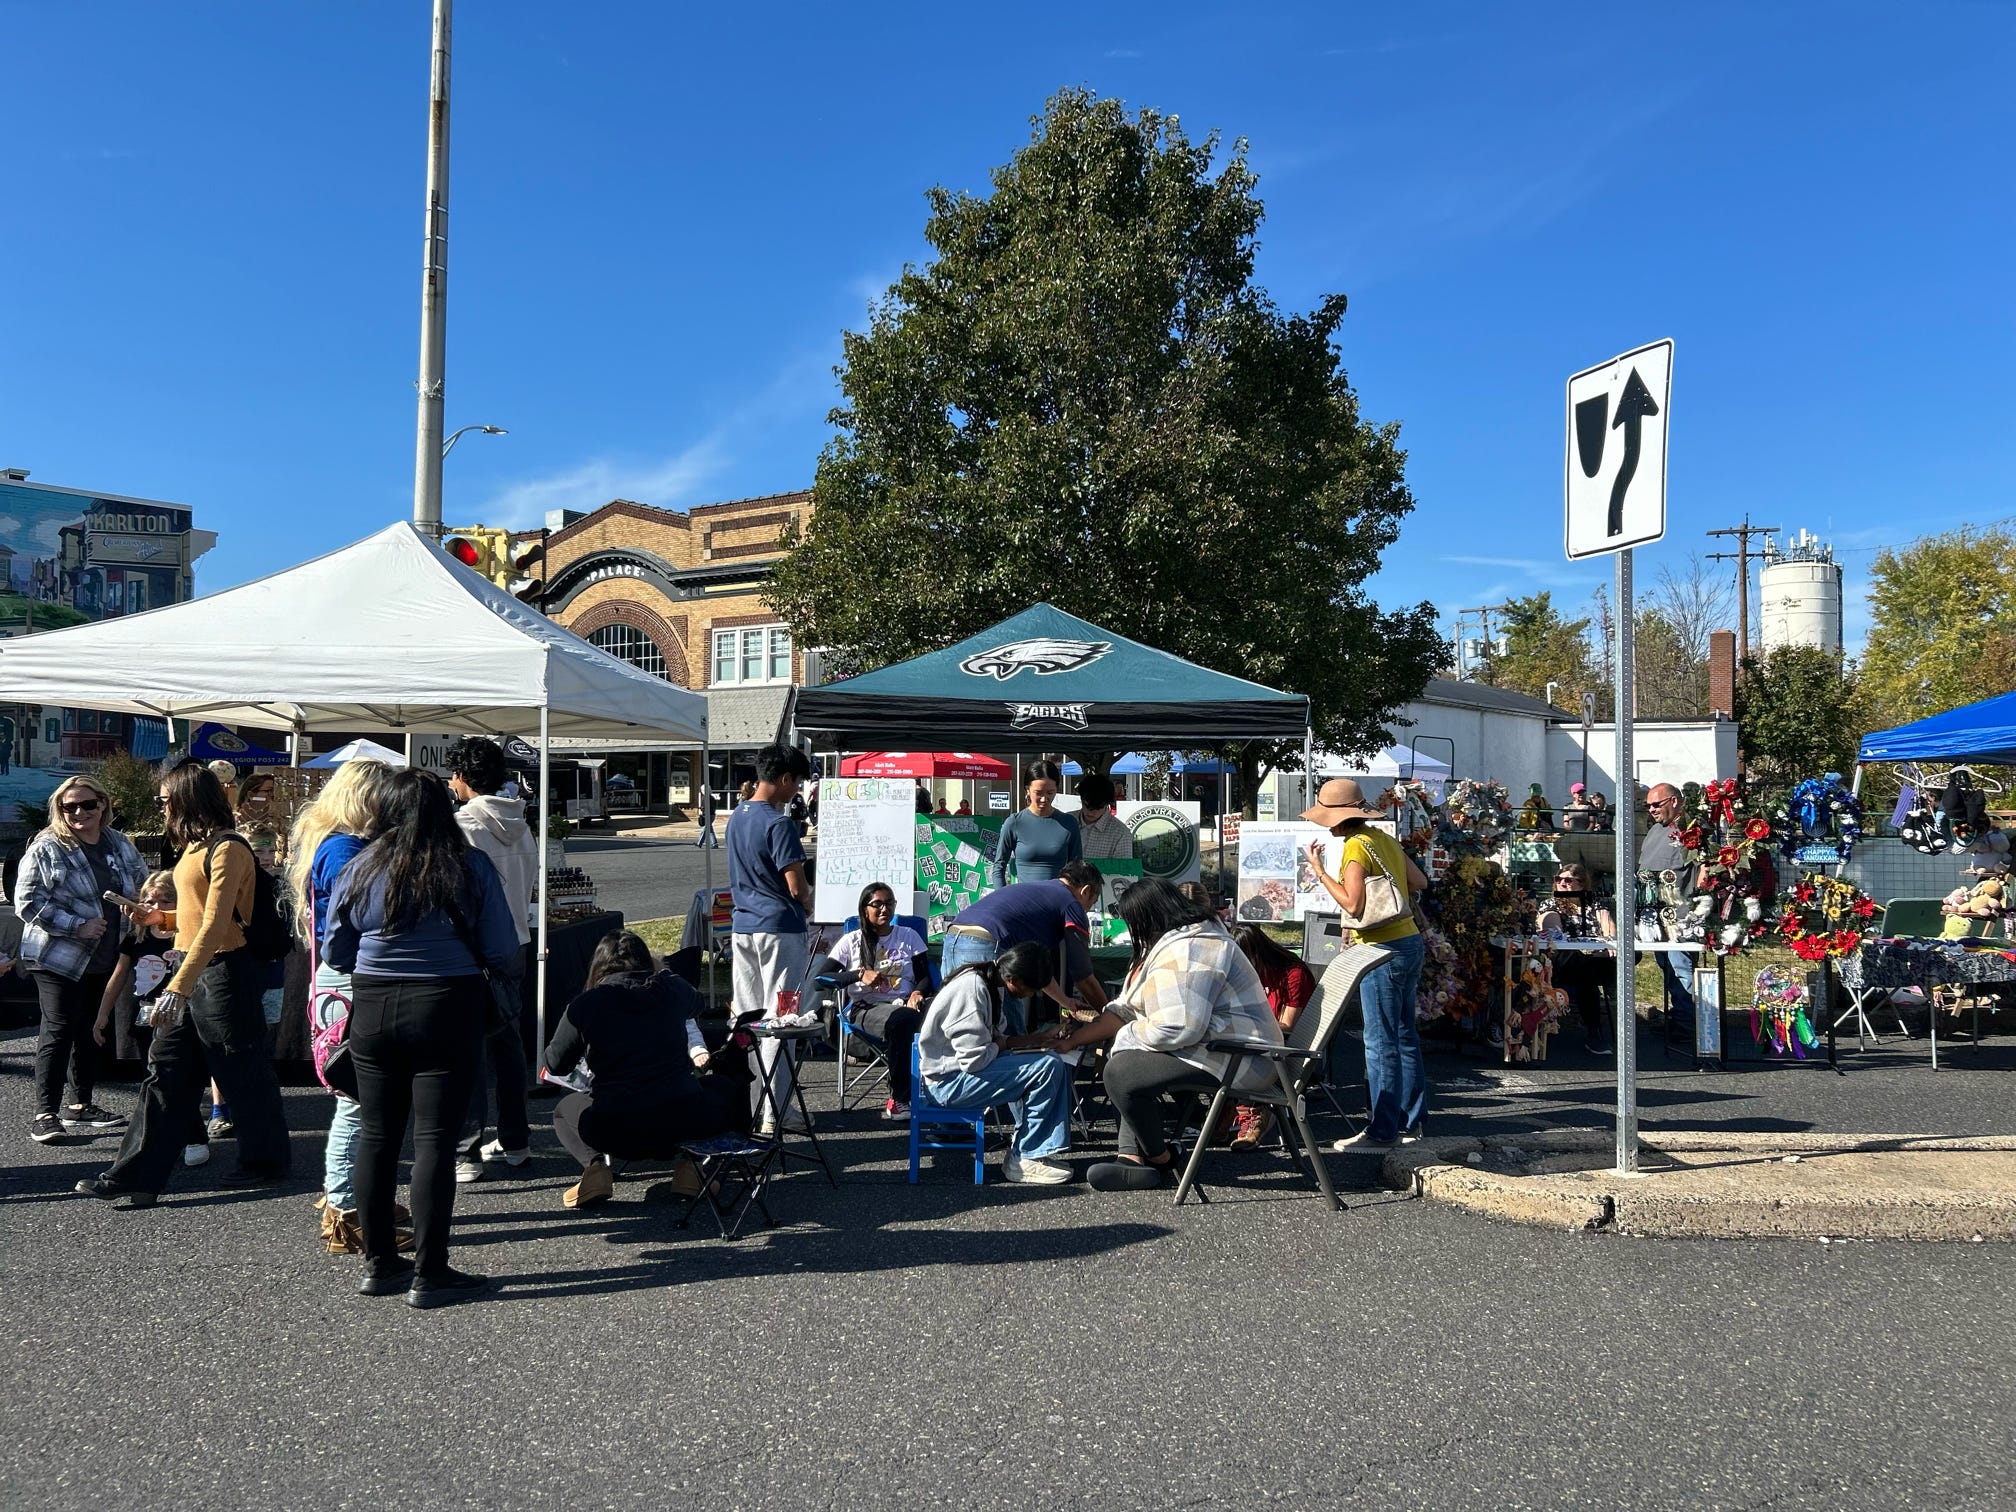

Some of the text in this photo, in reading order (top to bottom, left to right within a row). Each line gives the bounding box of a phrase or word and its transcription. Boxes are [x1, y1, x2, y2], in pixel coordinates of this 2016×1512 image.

[590, 564, 641, 582] PALACE
[1015, 703, 1085, 724] EAGLES
[420, 745, 447, 768] ONL
[1127, 807, 1193, 834] MICRO VRA FUND
[1700, 972, 1714, 1052] WINTER
